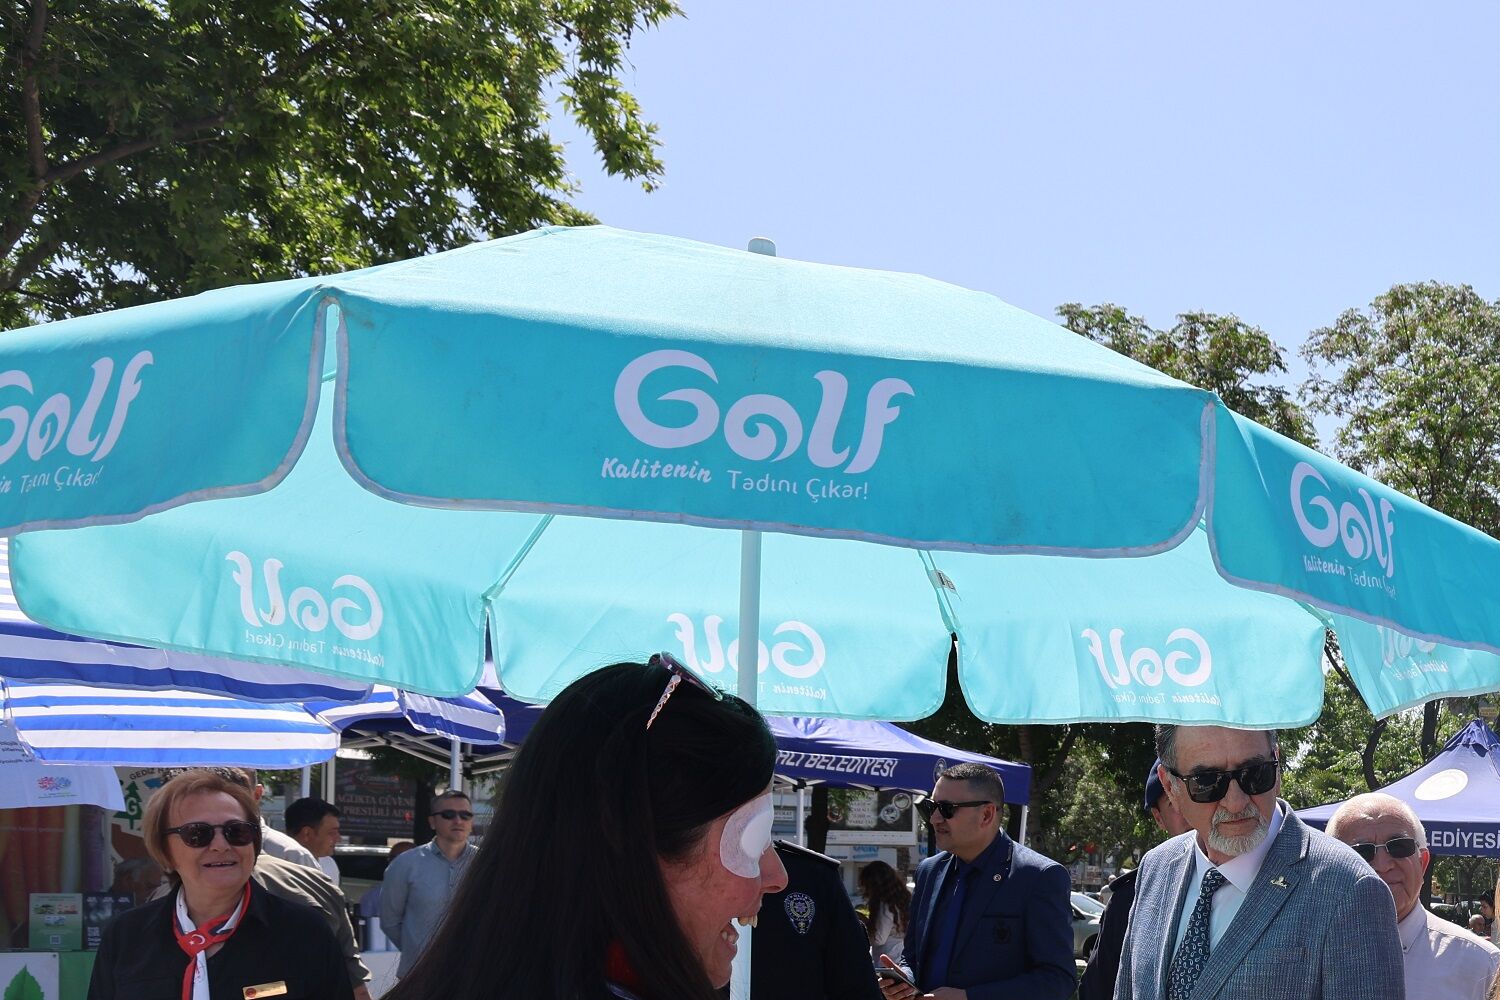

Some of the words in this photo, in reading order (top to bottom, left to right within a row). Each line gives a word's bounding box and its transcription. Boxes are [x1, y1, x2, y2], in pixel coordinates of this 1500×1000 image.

[613, 349, 916, 474] Golf
[601, 457, 712, 483] Kalitenin
[727, 470, 798, 495] Tadını
[806, 478, 868, 504] Çıkar!
[1290, 461, 1396, 578] Golf
